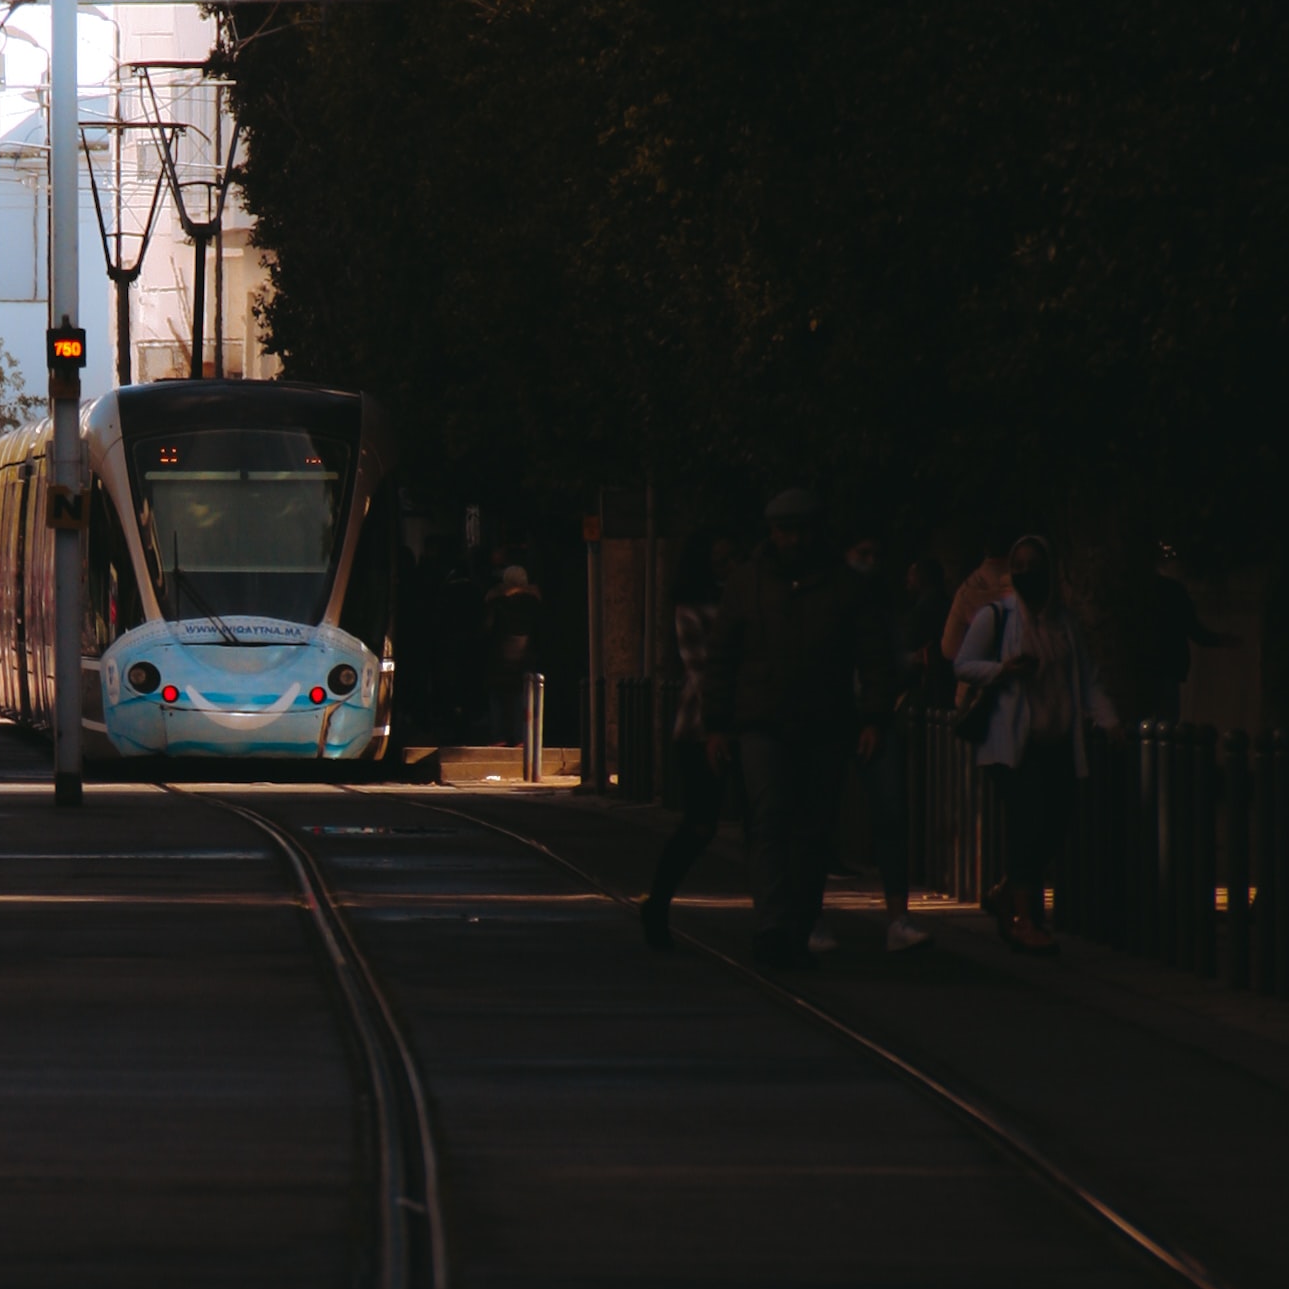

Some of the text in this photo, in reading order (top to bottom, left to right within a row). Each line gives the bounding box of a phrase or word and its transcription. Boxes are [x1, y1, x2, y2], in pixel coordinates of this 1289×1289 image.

[54, 340, 82, 358] 750
[54, 494, 82, 521] N
[185, 624, 302, 637] WWWWIQAYTNA.MA
